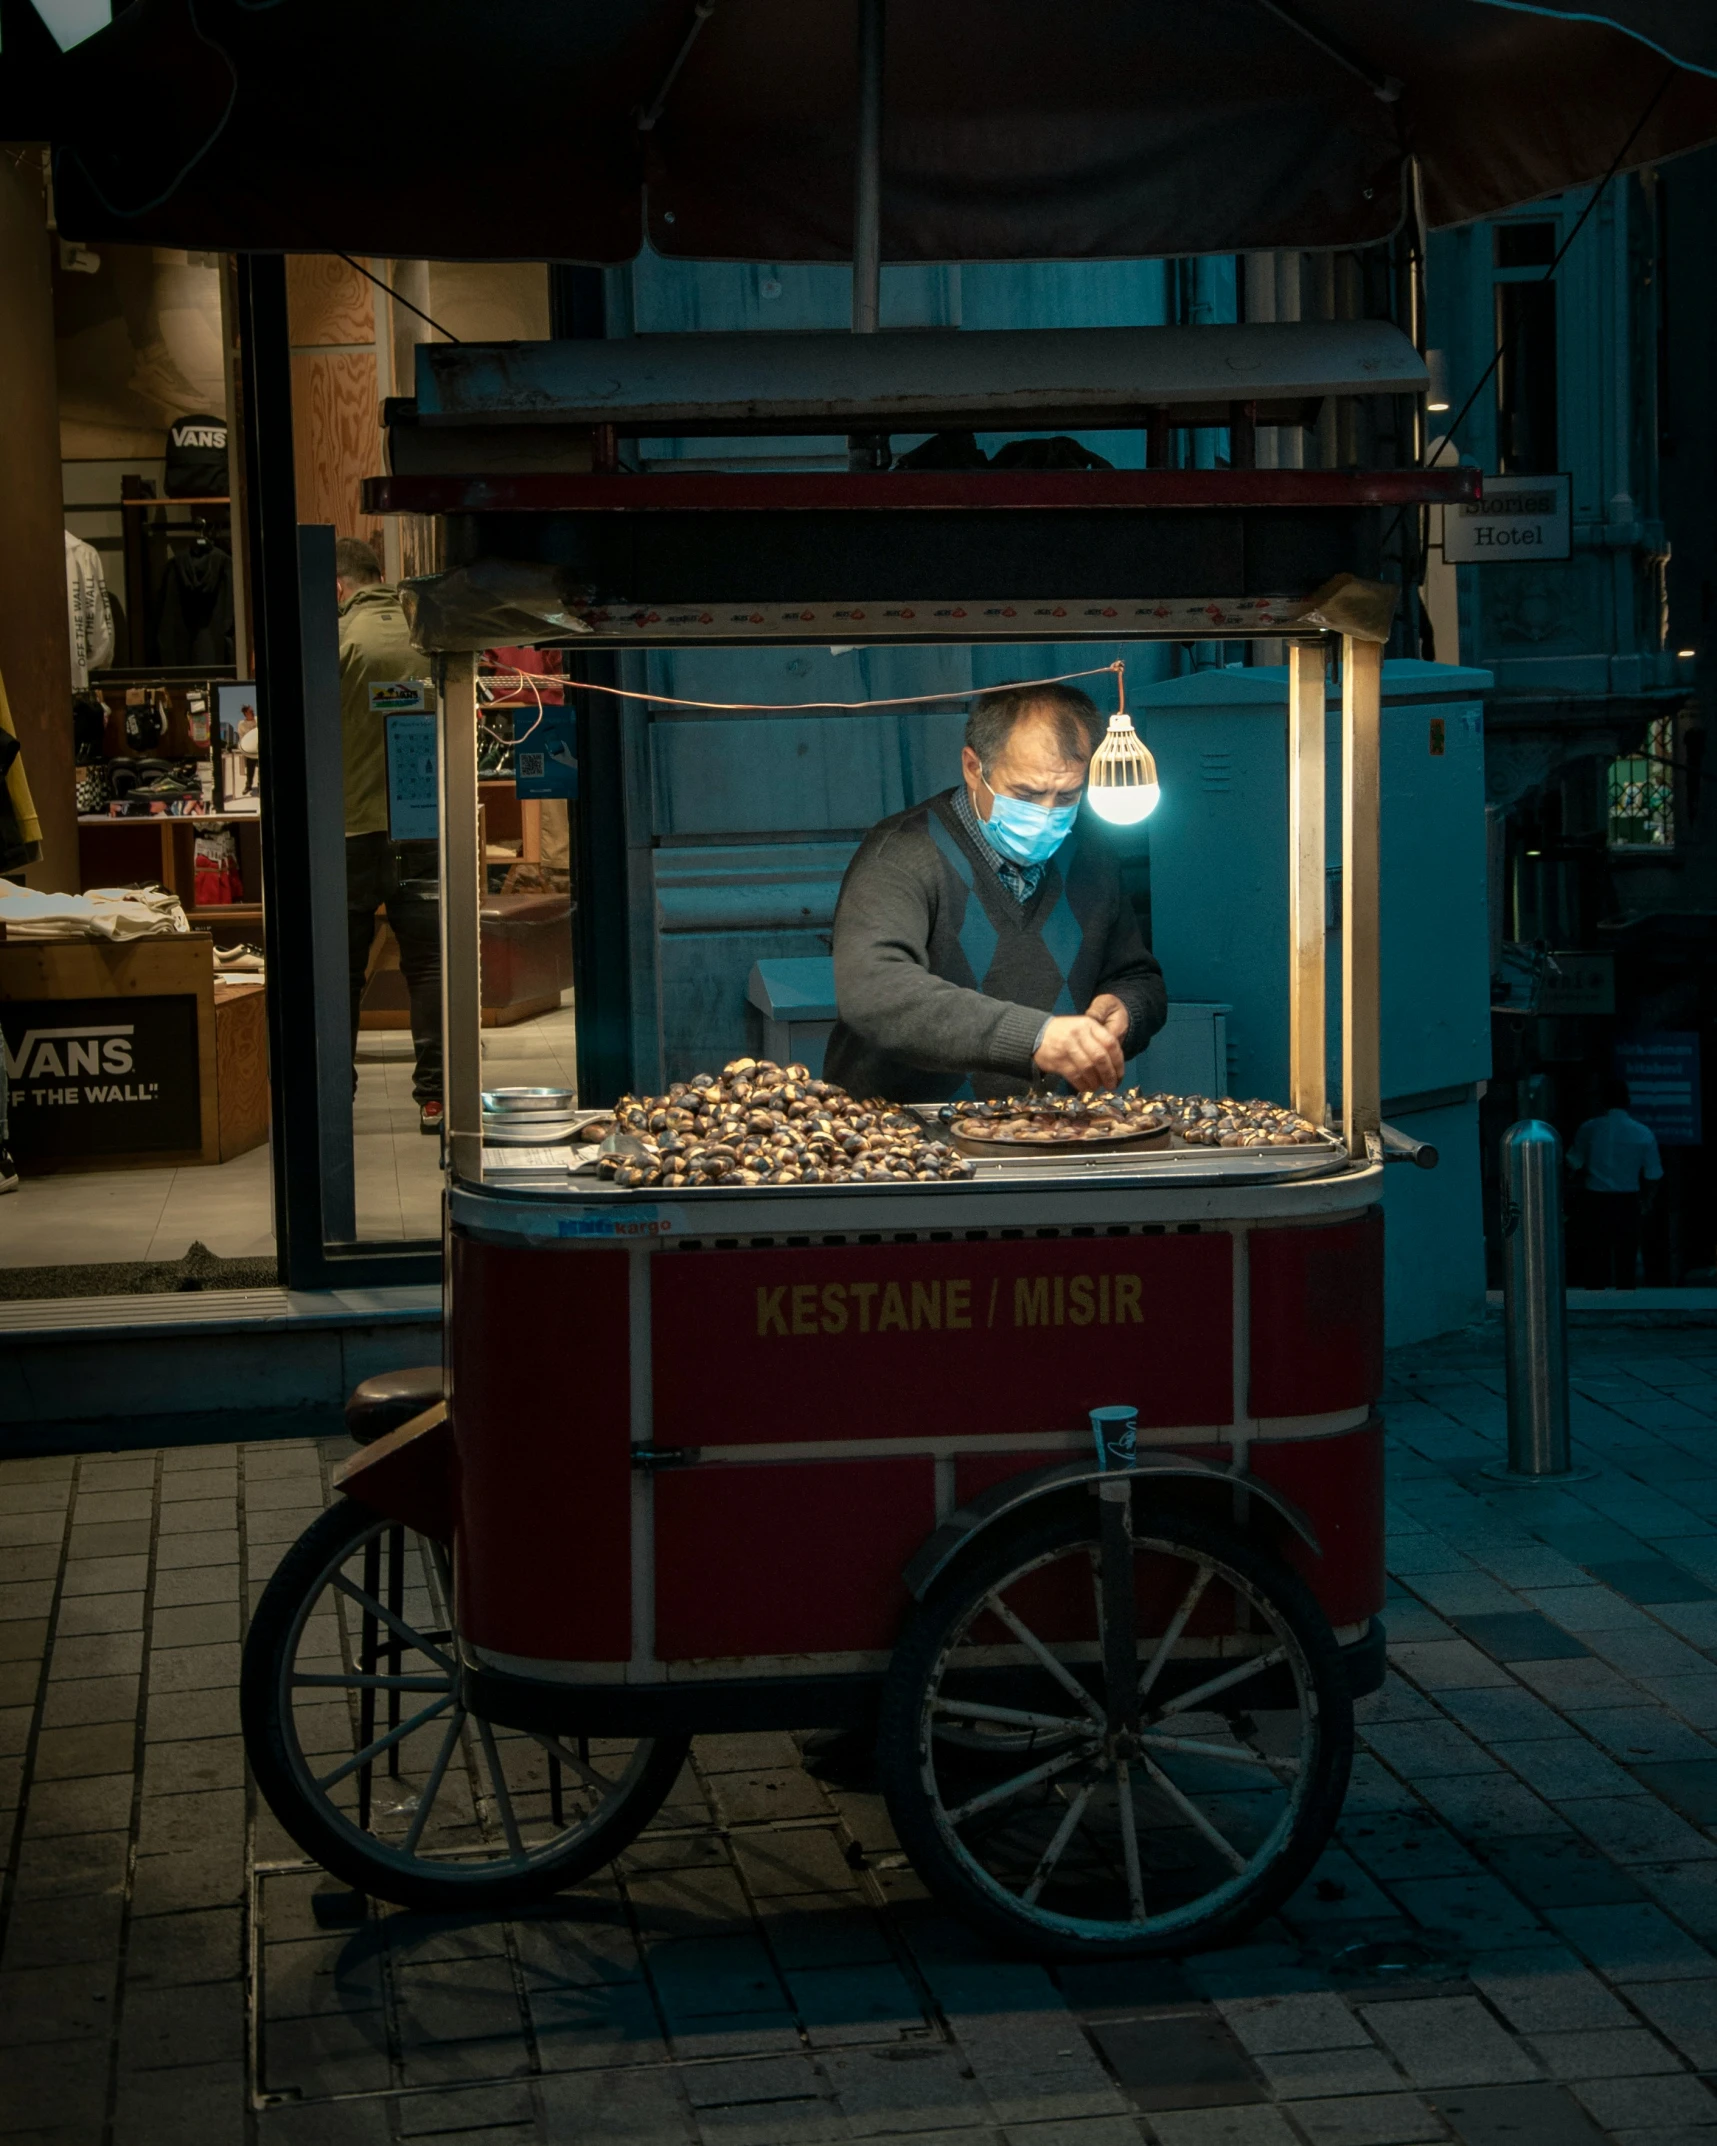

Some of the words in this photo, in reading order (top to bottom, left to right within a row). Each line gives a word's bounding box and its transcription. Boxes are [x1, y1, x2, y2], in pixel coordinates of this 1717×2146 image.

[171, 426, 228, 449] VANS
[1465, 495, 1551, 514] Stories
[1474, 525, 1544, 546] Hotel
[72, 580, 83, 612] WALL
[75, 615, 85, 640] THE
[76, 642, 86, 667] OFF
[3, 1024, 135, 1080] VANS
[30, 1086, 79, 1107] THE
[755, 1278, 973, 1337] KESTANE
[1013, 1273, 1145, 1328] MISIR
